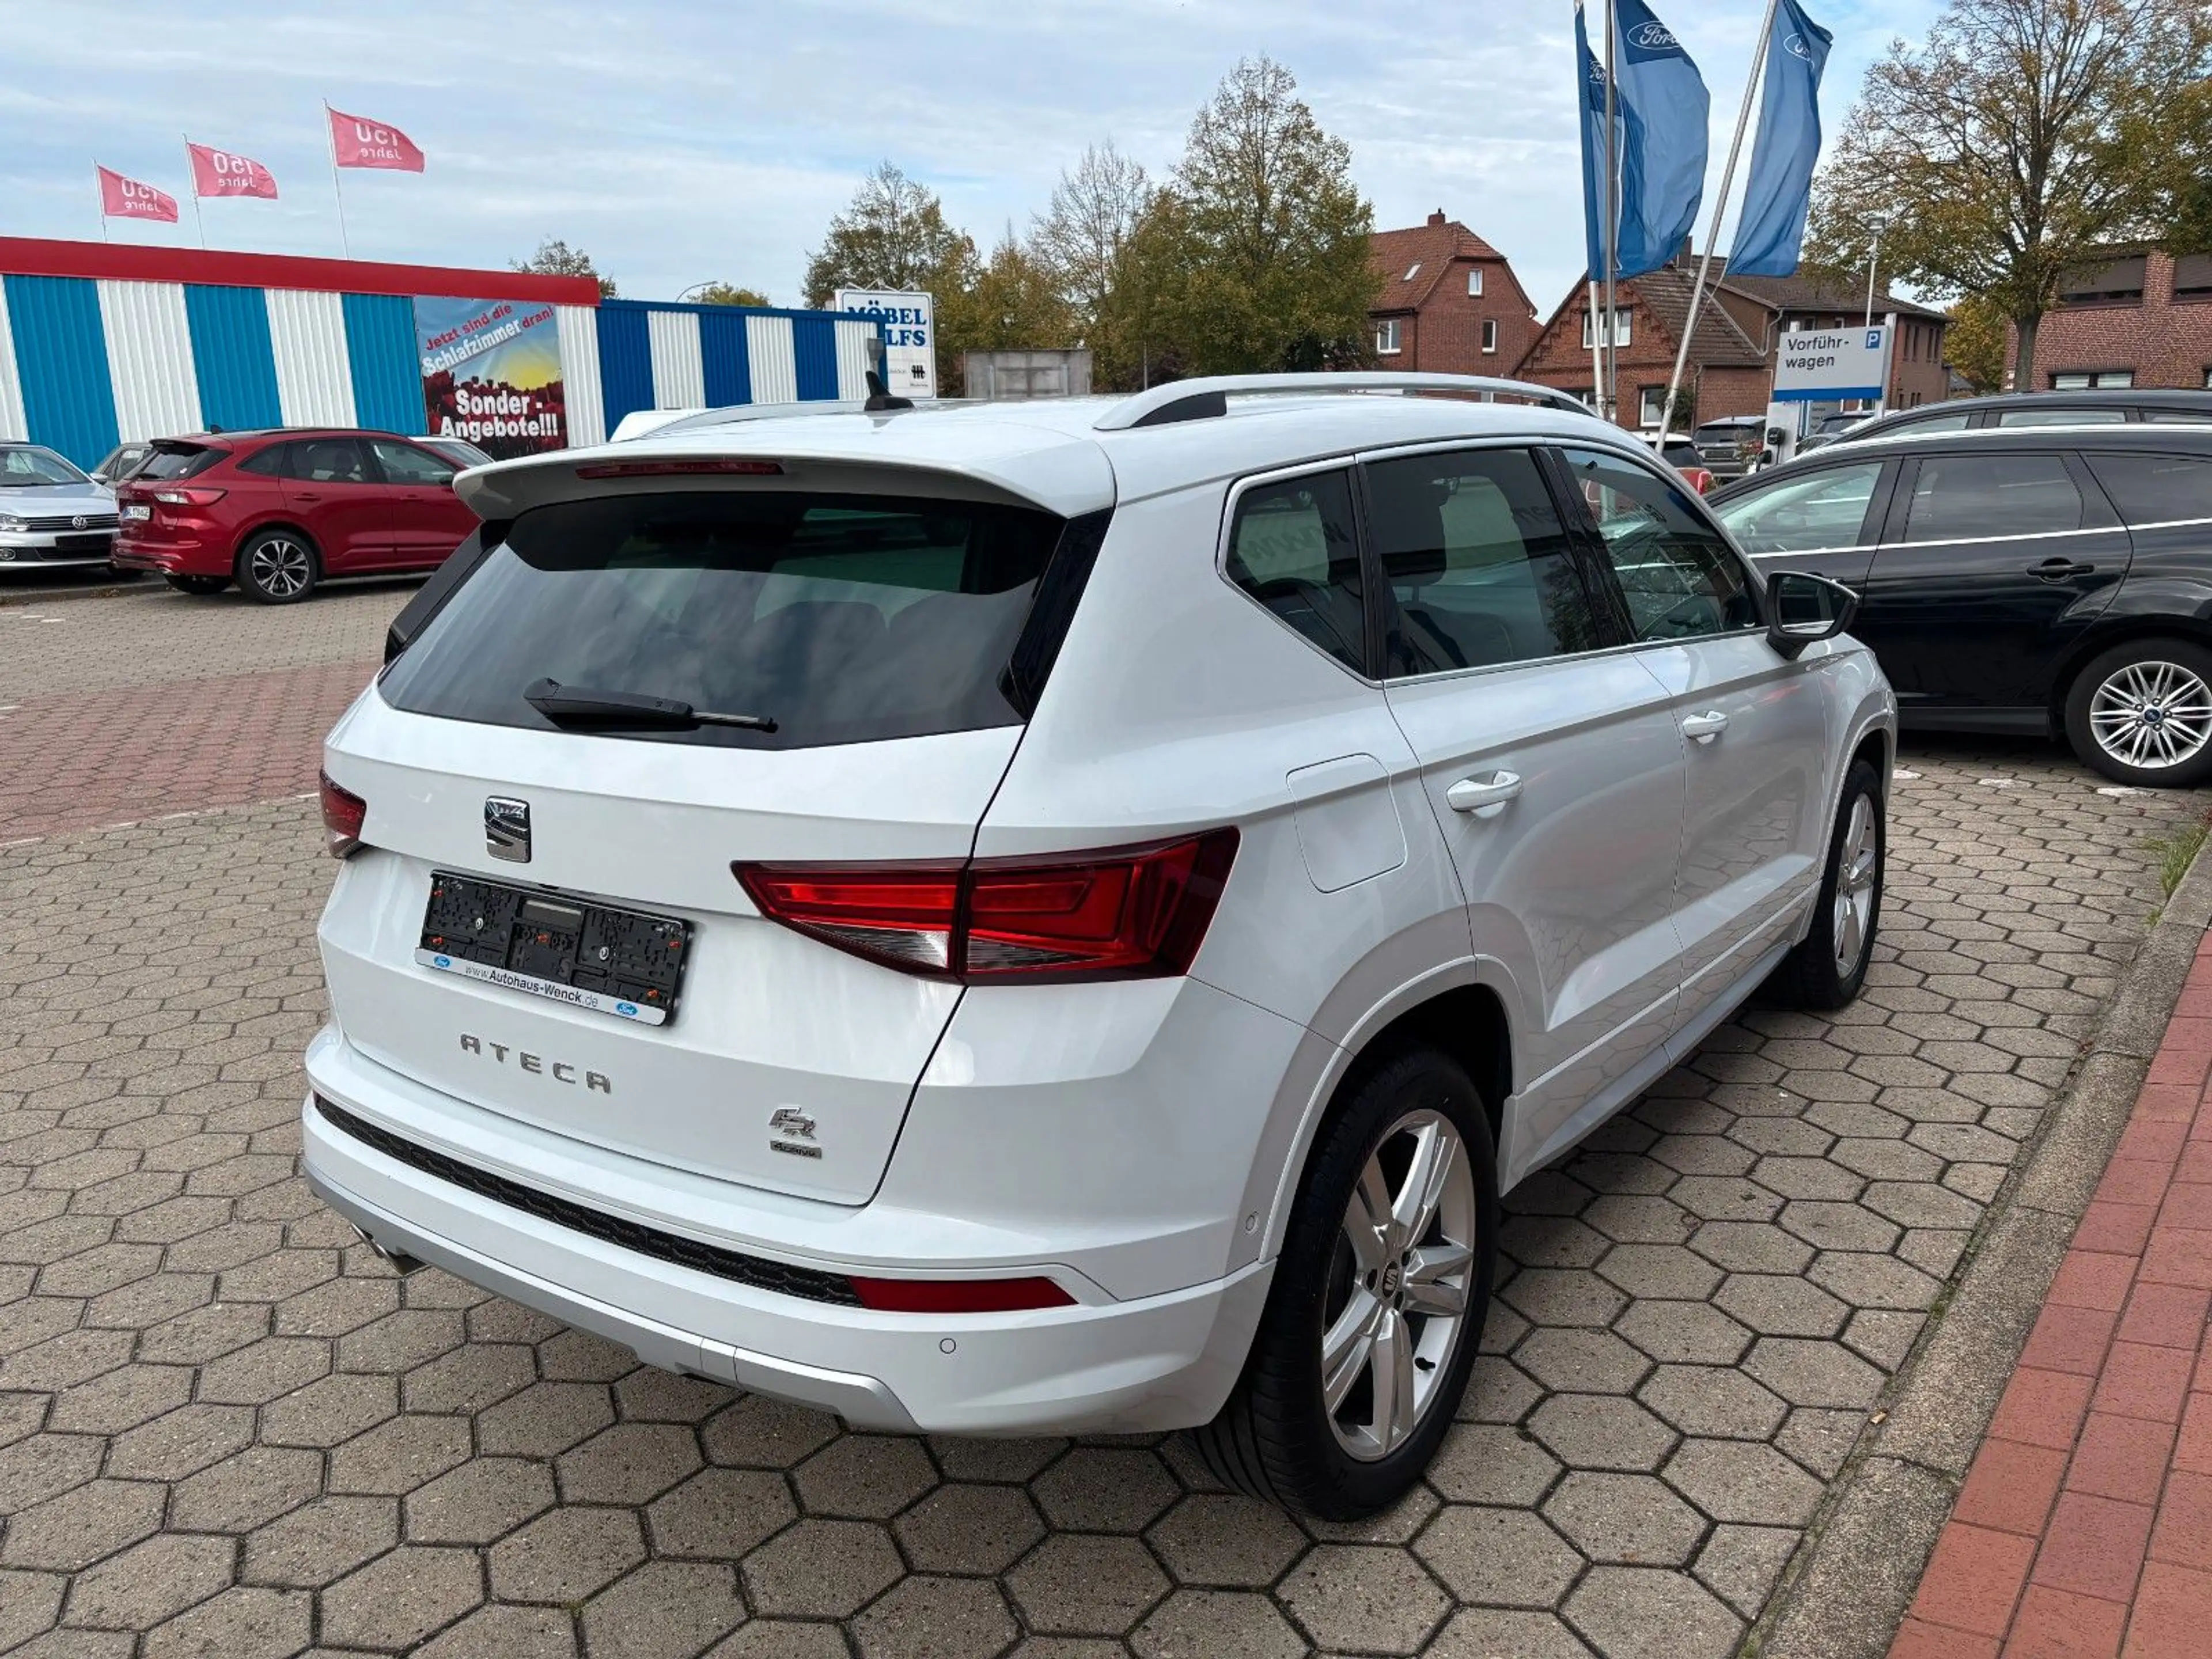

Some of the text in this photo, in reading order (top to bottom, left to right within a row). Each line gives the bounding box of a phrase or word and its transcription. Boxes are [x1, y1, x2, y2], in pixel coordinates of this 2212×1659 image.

[422, 306, 554, 374] Schlafzimmer dran!
[426, 304, 513, 350] Jetzt sind die
[1868, 333, 1878, 346] P
[1788, 336, 1849, 350] Vorführ-
[1786, 357, 1834, 370] wagen
[455, 389, 531, 415] Sonder
[441, 413, 558, 442] Angebote!!!
[460, 1034, 611, 1094] ATECA
